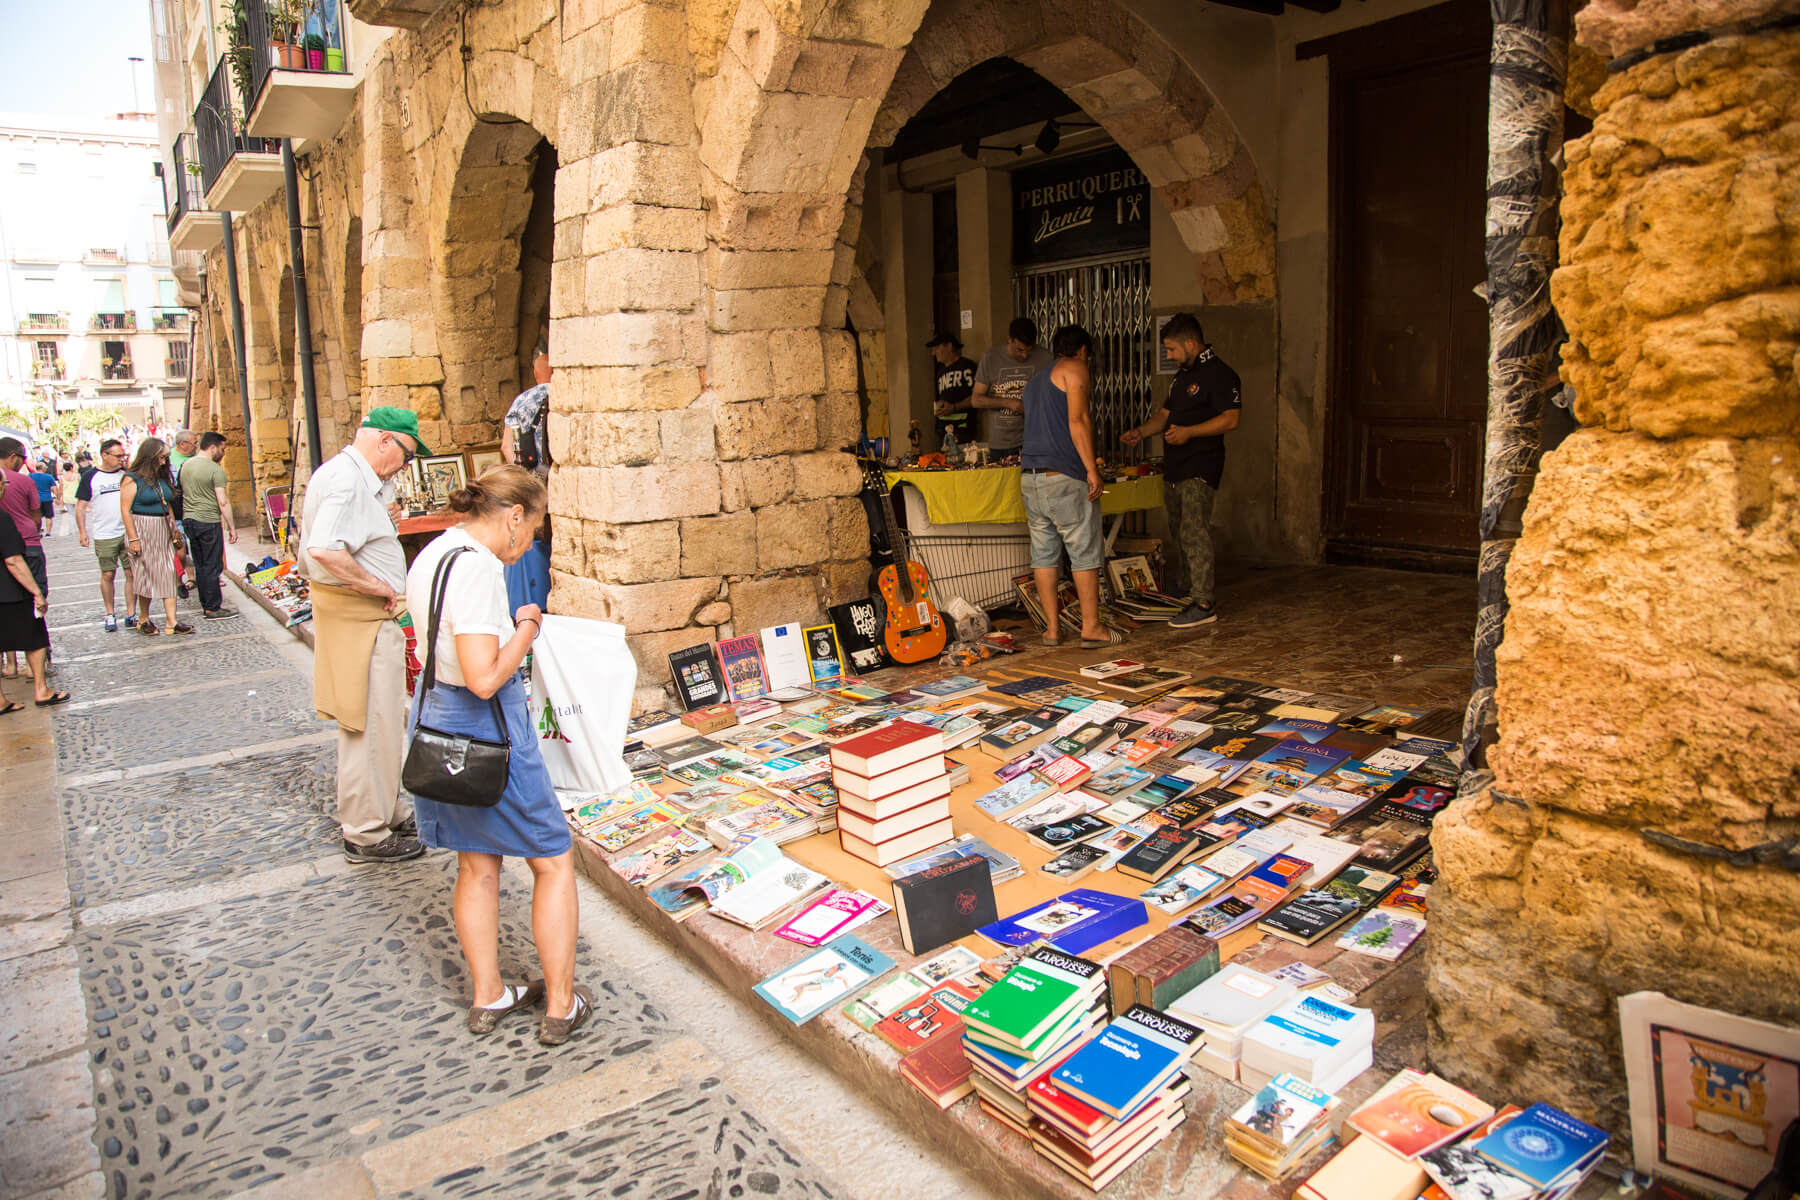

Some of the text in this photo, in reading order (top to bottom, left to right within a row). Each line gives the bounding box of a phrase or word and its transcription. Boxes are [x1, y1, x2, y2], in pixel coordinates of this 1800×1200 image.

[1021, 167, 1149, 208] PERRUQUERI
[1034, 205, 1095, 242] Janin
[720, 636, 755, 656] TEMAS
[1294, 744, 1329, 757] CHINA
[850, 945, 874, 965] Tenis
[1034, 949, 1093, 977] LAROUSSE
[1128, 1008, 1192, 1042] LAROUSSE
